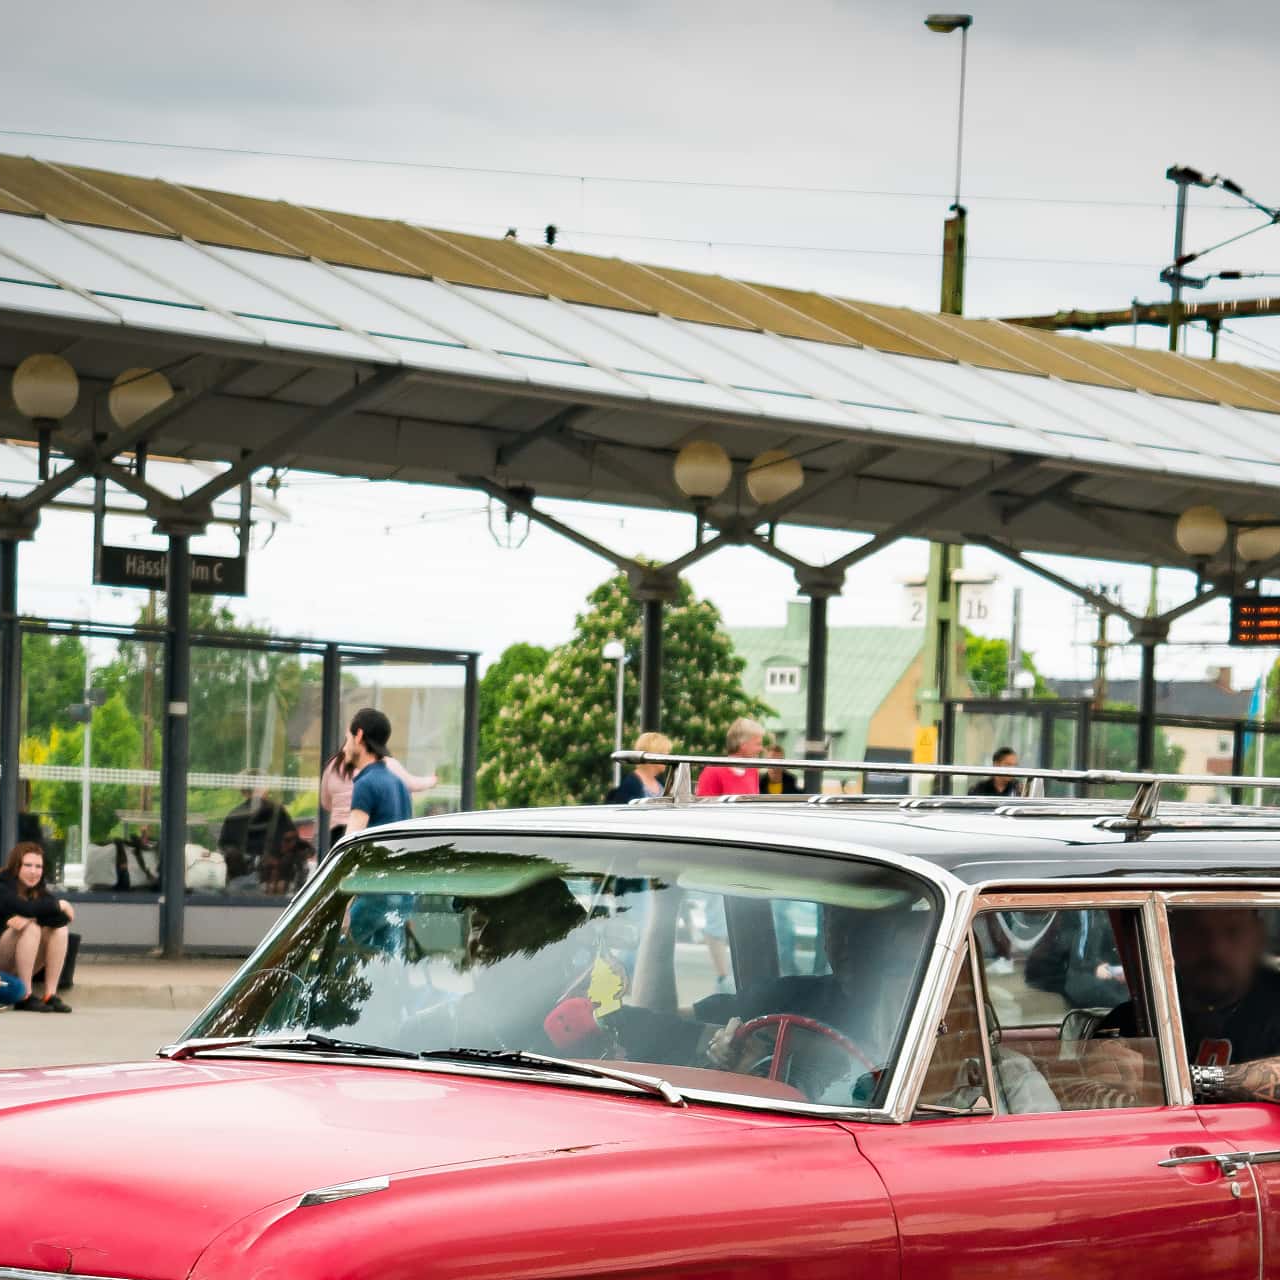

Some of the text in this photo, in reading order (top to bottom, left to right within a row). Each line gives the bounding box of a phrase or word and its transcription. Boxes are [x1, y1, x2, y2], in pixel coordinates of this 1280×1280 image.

[126, 553, 224, 583] Hässllm C
[911, 600, 923, 622] 2
